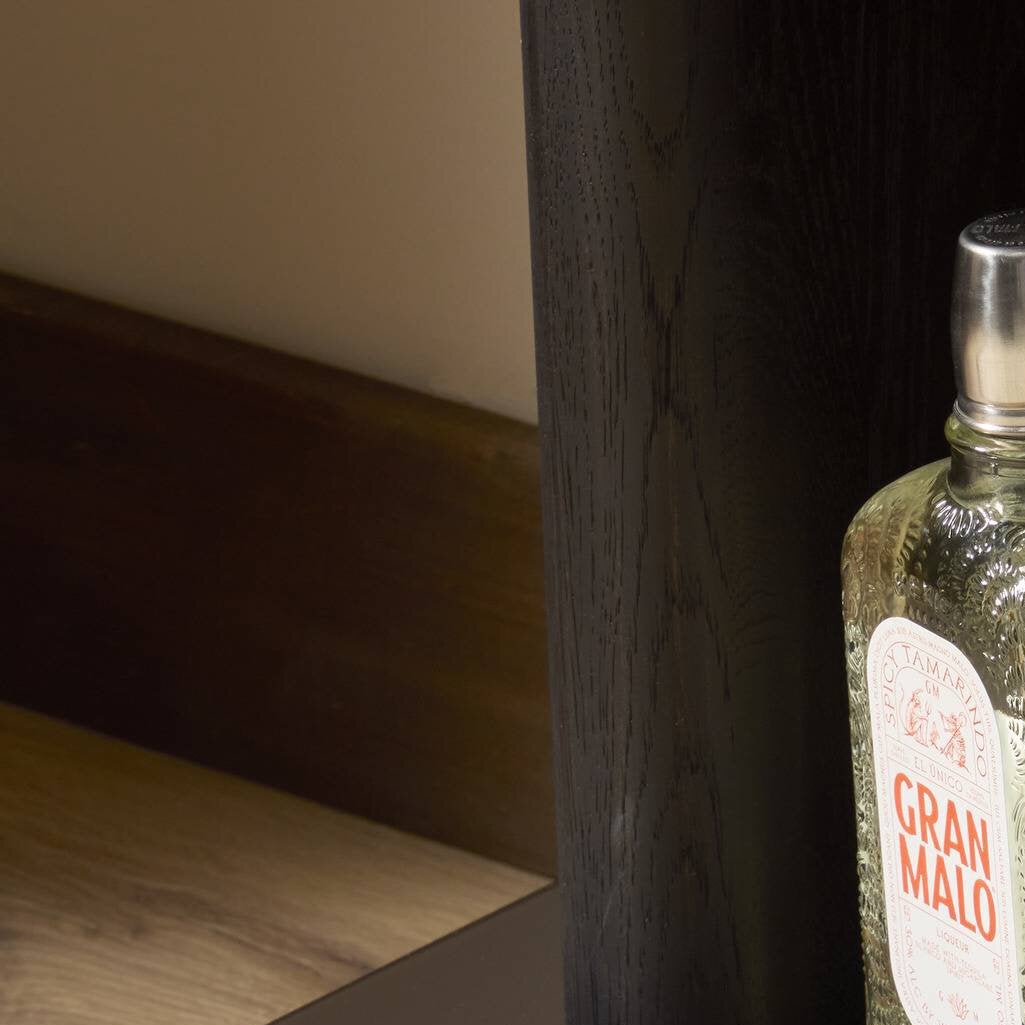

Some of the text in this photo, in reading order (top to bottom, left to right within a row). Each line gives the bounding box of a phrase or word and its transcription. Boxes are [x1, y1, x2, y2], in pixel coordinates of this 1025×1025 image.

[882, 648, 899, 729] SPICY
[902, 645, 987, 778] TAMARINDO
[893, 772, 991, 881] GRAN
[898, 832, 997, 943] MALO
